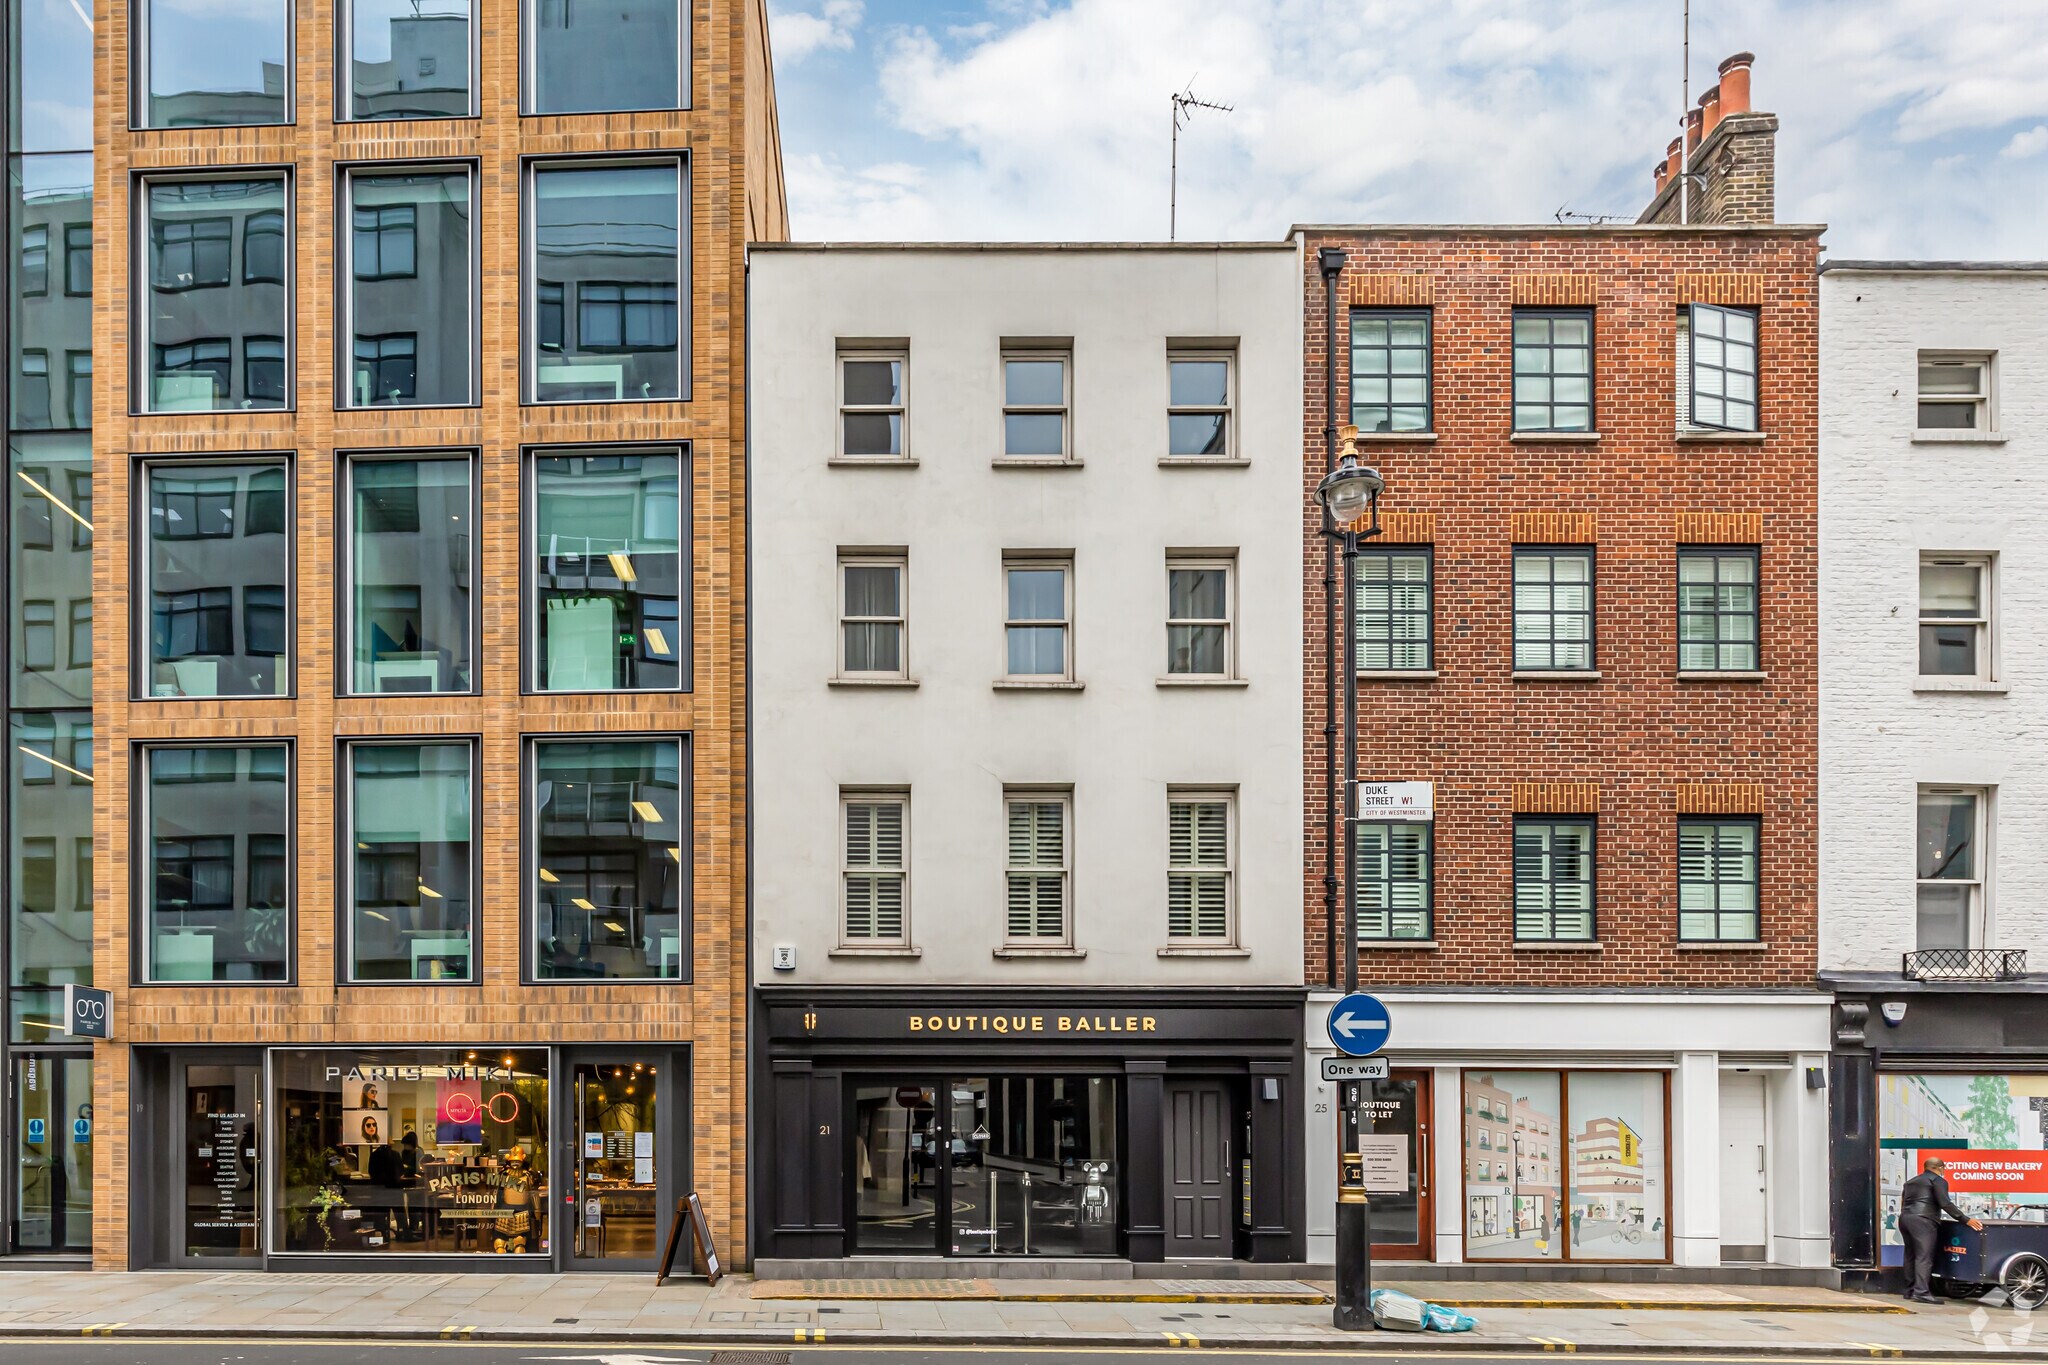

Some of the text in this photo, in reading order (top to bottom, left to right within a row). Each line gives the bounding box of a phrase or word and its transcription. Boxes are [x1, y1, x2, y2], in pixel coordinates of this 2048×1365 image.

[1366, 786, 1388, 794] DUKE
[1366, 796, 1413, 805] STREET W1
[909, 1016, 1156, 1034] BOUTIQUE BALLER
[326, 1066, 513, 1080] PARIS MIKI
[1328, 1064, 1382, 1075] One way
[1314, 1104, 1328, 1112] 25
[820, 1126, 830, 1134] 21
[2004, 1162, 2042, 1170] BAKERY
[428, 1172, 526, 1193] PARIS MIKI
[456, 1194, 497, 1204] LONDON
